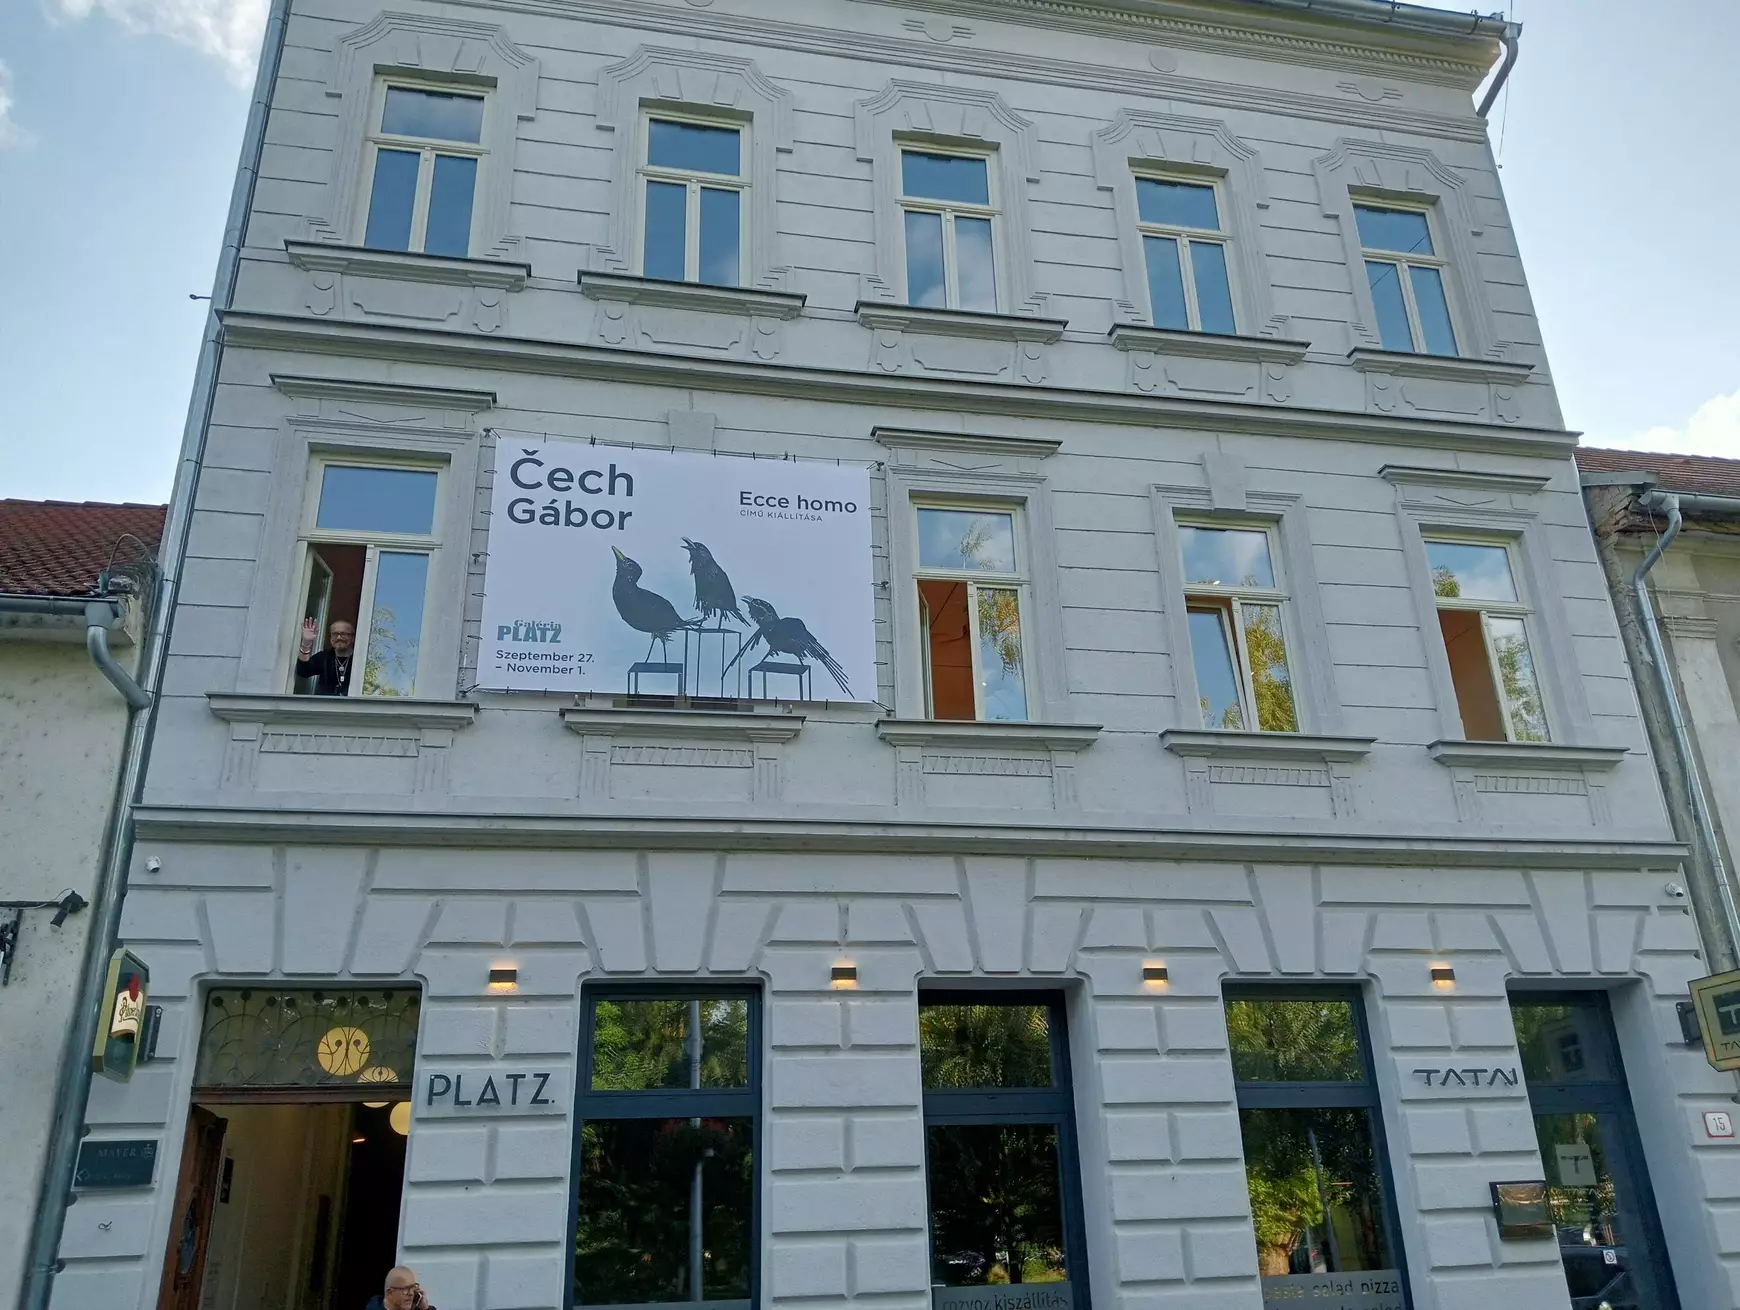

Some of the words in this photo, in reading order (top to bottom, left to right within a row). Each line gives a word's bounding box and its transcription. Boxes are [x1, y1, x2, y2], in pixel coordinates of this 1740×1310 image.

[510, 448, 634, 497] Čech
[740, 491, 790, 508] Ecce
[797, 495, 857, 513] homo
[507, 497, 633, 531] Gábor
[767, 511, 823, 522] KIÁLLÍTÁSA
[514, 619, 561, 631] Galéria
[497, 625, 562, 643] PLATZ
[496, 649, 574, 662] Szeptember
[577, 653, 595, 663] 27.
[506, 663, 574, 675] November
[577, 666, 586, 675] 1.
[427, 1073, 555, 1106] PLATZ.
[1713, 1117, 1726, 1131] 15
